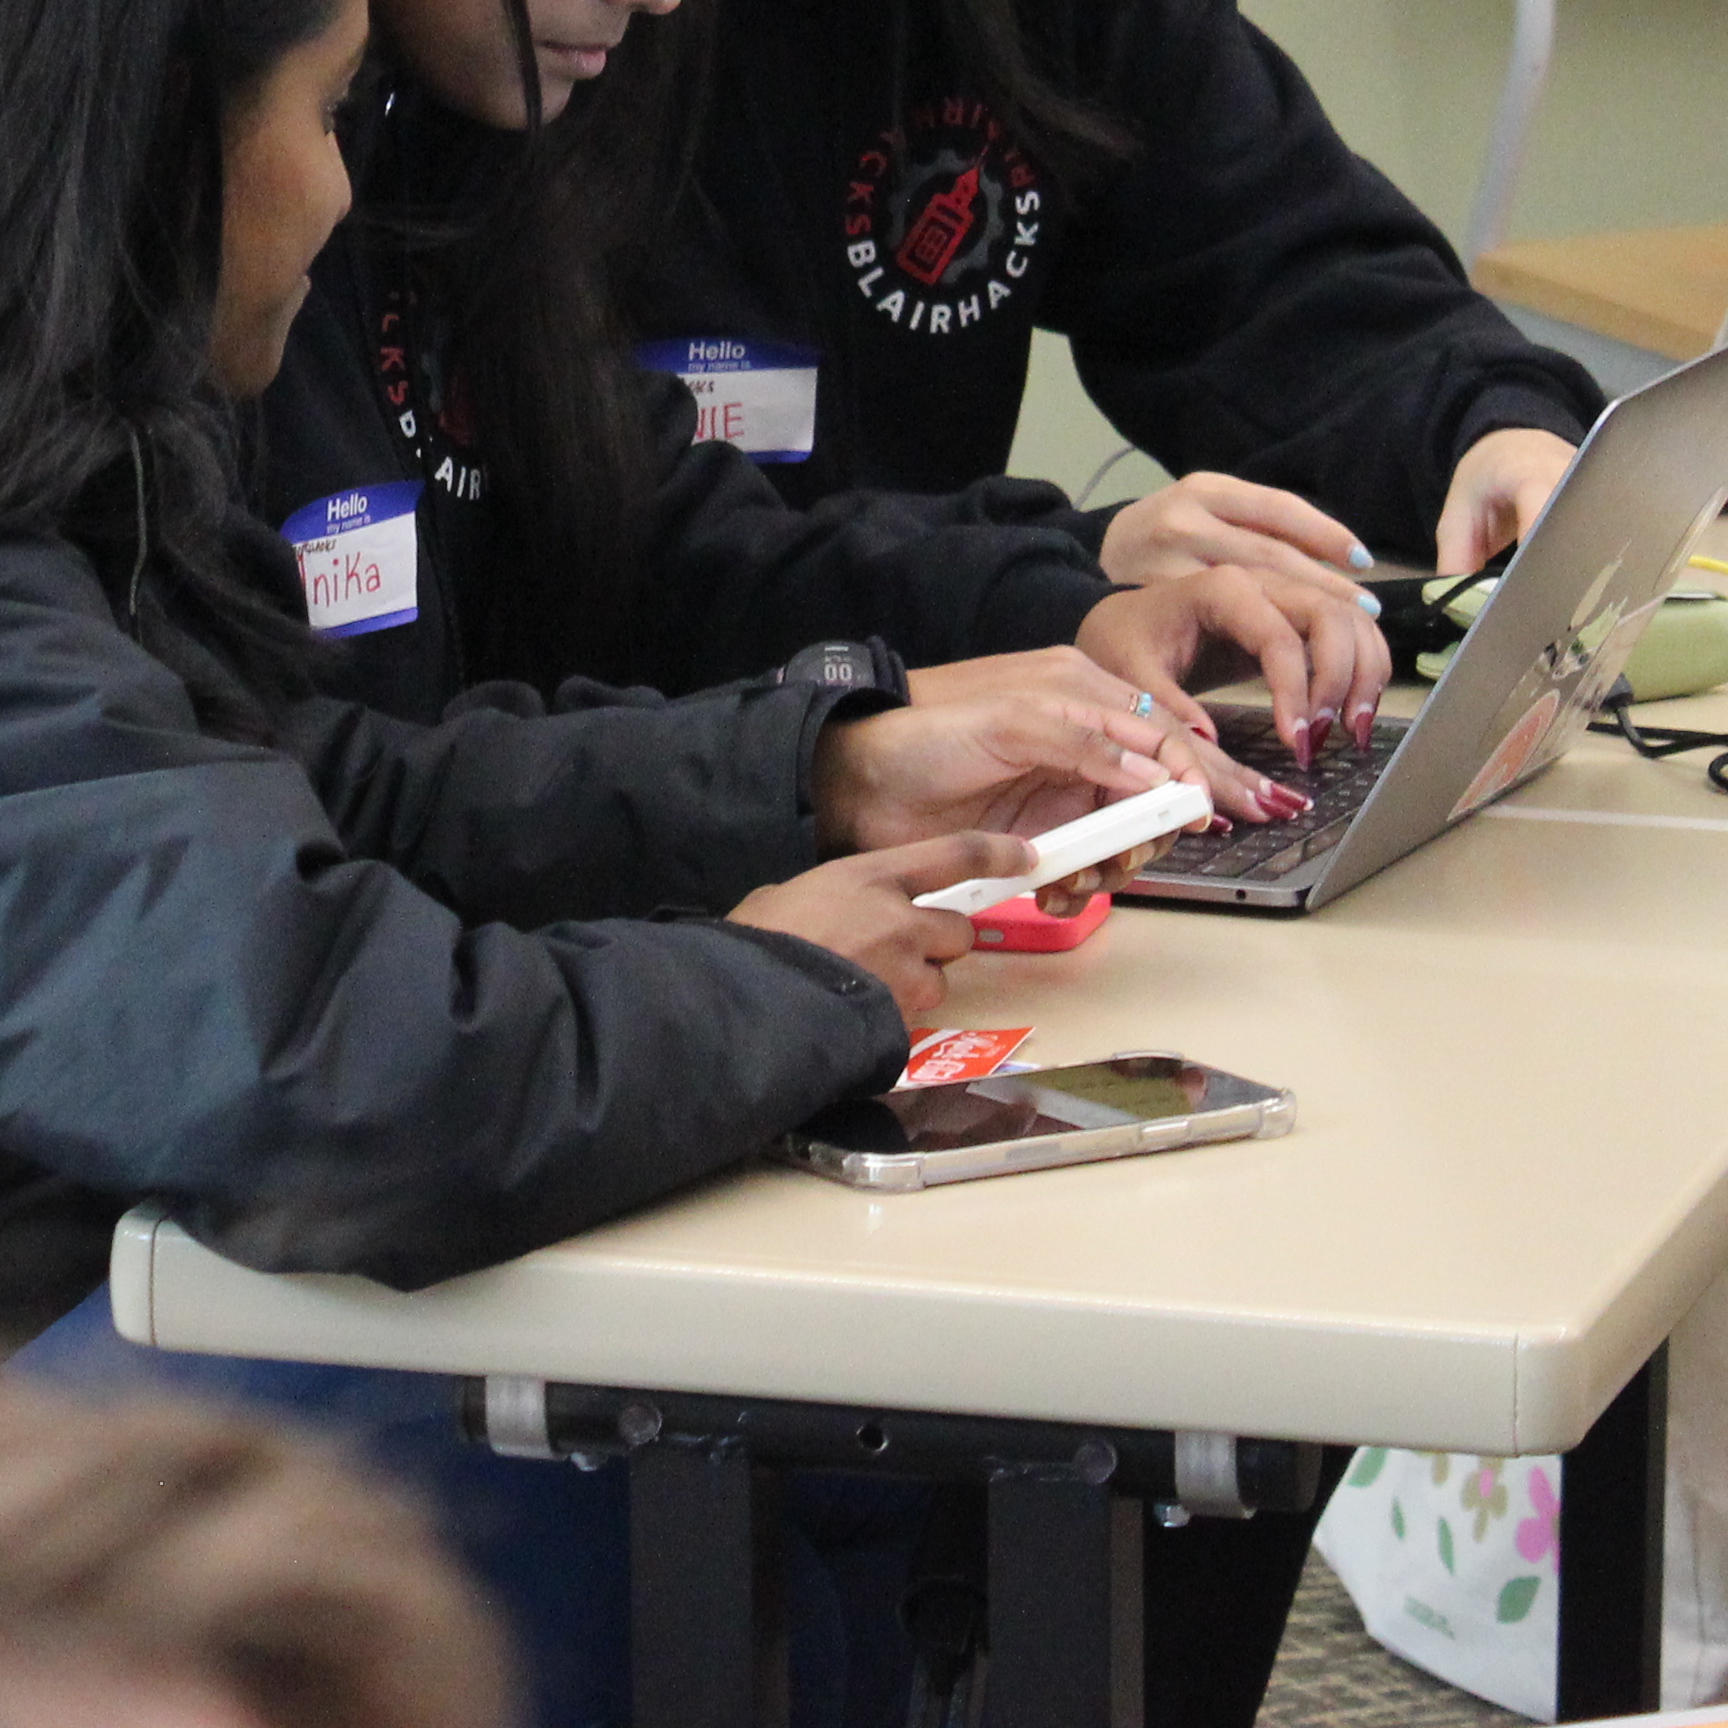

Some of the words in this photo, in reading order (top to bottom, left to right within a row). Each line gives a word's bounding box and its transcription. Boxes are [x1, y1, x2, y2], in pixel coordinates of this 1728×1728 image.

[847, 190, 1040, 333] BLAIRHACKS
[688, 341, 745, 361] Hello
[327, 493, 368, 522] Hello
